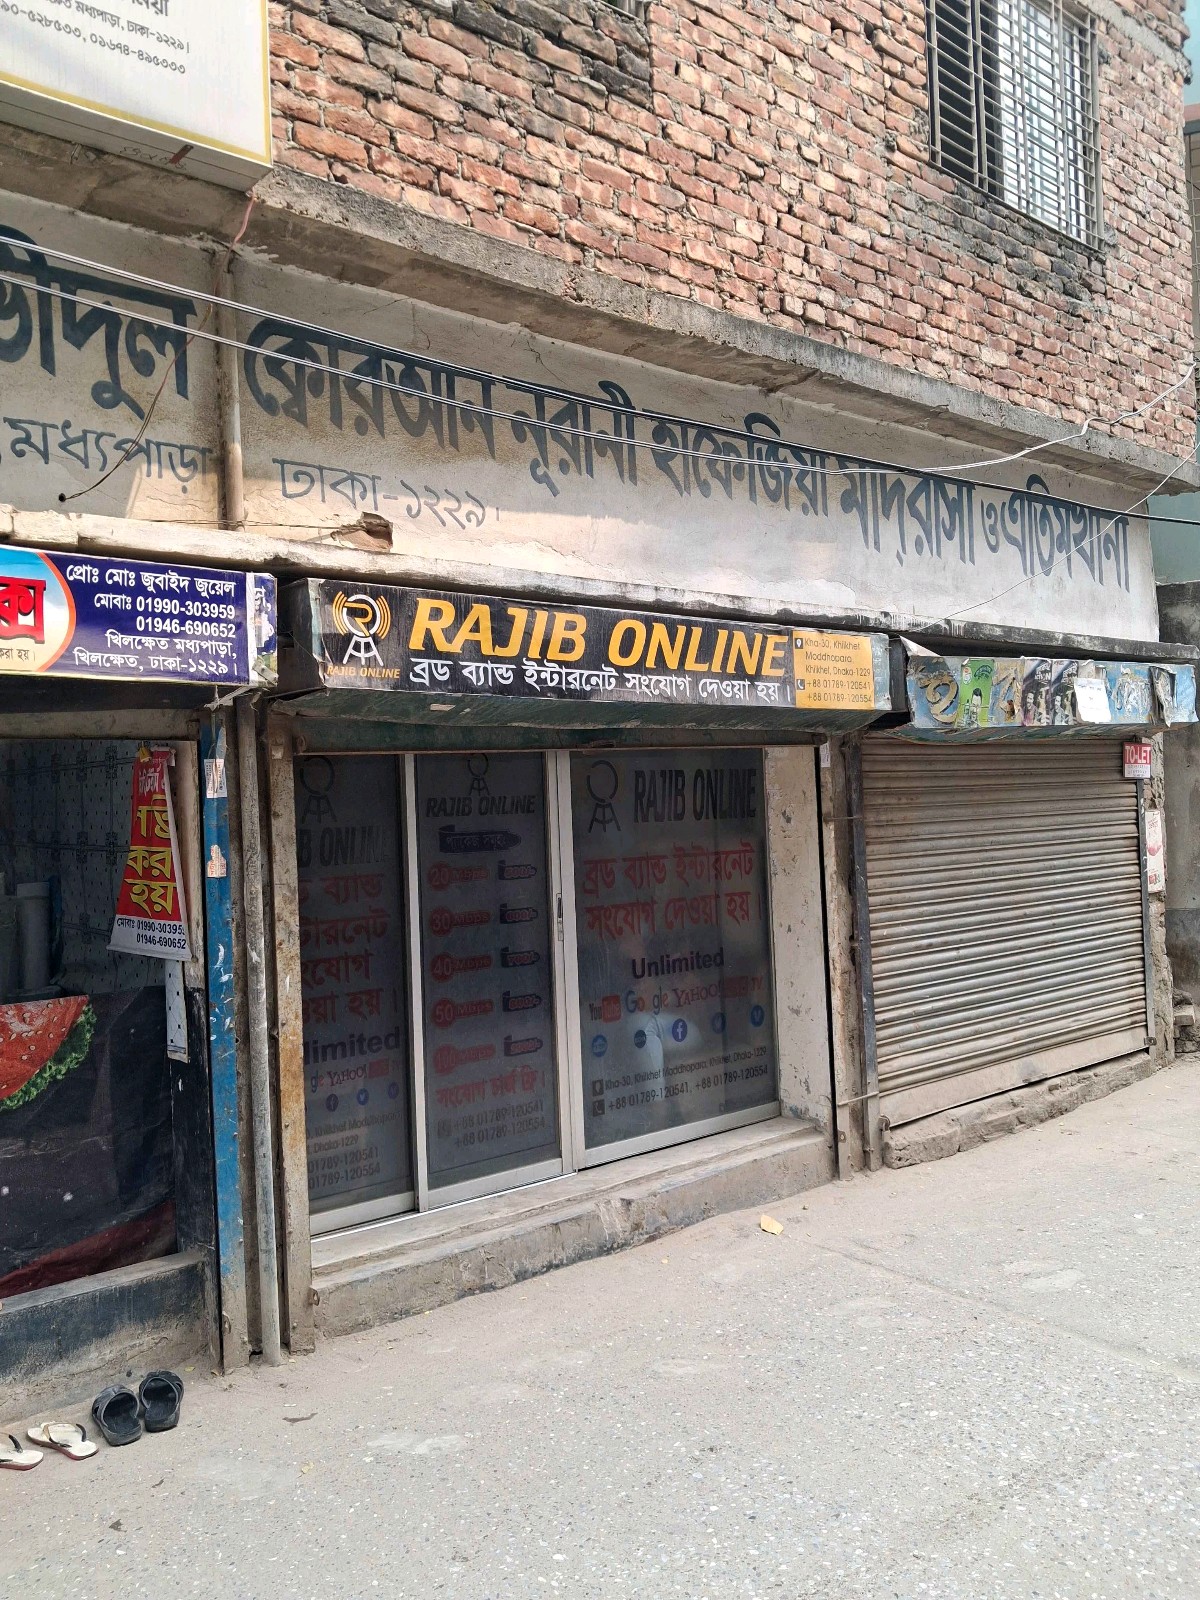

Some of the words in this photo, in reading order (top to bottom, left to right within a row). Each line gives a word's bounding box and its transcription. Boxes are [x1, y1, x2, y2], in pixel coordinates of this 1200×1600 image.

[66, 564, 99, 584] প্রোঃ
[105, 565, 136, 588] মোঃ
[140, 569, 190, 597] জুবাইদ
[194, 573, 236, 599] জুয়েল
[94, 592, 132, 612] মোবাঃ
[136, 595, 235, 620] 01990-303959
[105, 629, 169, 650] খিলক্ষেত
[136, 615, 236, 639] 01946-690652
[408, 598, 588, 663] RAJIB
[608, 619, 789, 678] ONLINE
[360, 667, 401, 679] ONLINE
[409, 657, 453, 687] ব্রড
[459, 659, 516, 688] ব্যান্ড
[521, 657, 619, 693] ইন্টারনেট
[624, 673, 692, 697] সংযোগ
[698, 677, 751, 701] দেওয়া
[755, 681, 781, 703] হয়
[1124, 745, 1151, 764] TO-LET
[425, 795, 473, 818] RAJIB
[478, 794, 537, 817] ONLINE
[633, 769, 686, 823] RAJIB
[693, 767, 757, 821] ONLINE
[430, 868, 449, 886] 20
[582, 858, 618, 898] ব্রড
[622, 852, 669, 889] ব্যান্ড
[432, 913, 451, 931] 30
[584, 895, 659, 941] সংযোগ
[664, 891, 721, 931] দেওয়া
[724, 891, 752, 926] হয়
[136, 932, 187, 950] 01946-690652
[434, 958, 452, 976] 40
[631, 947, 725, 979] Unlimited
[626, 986, 669, 1015] Gogle
[672, 979, 722, 1008] YAHOO!
